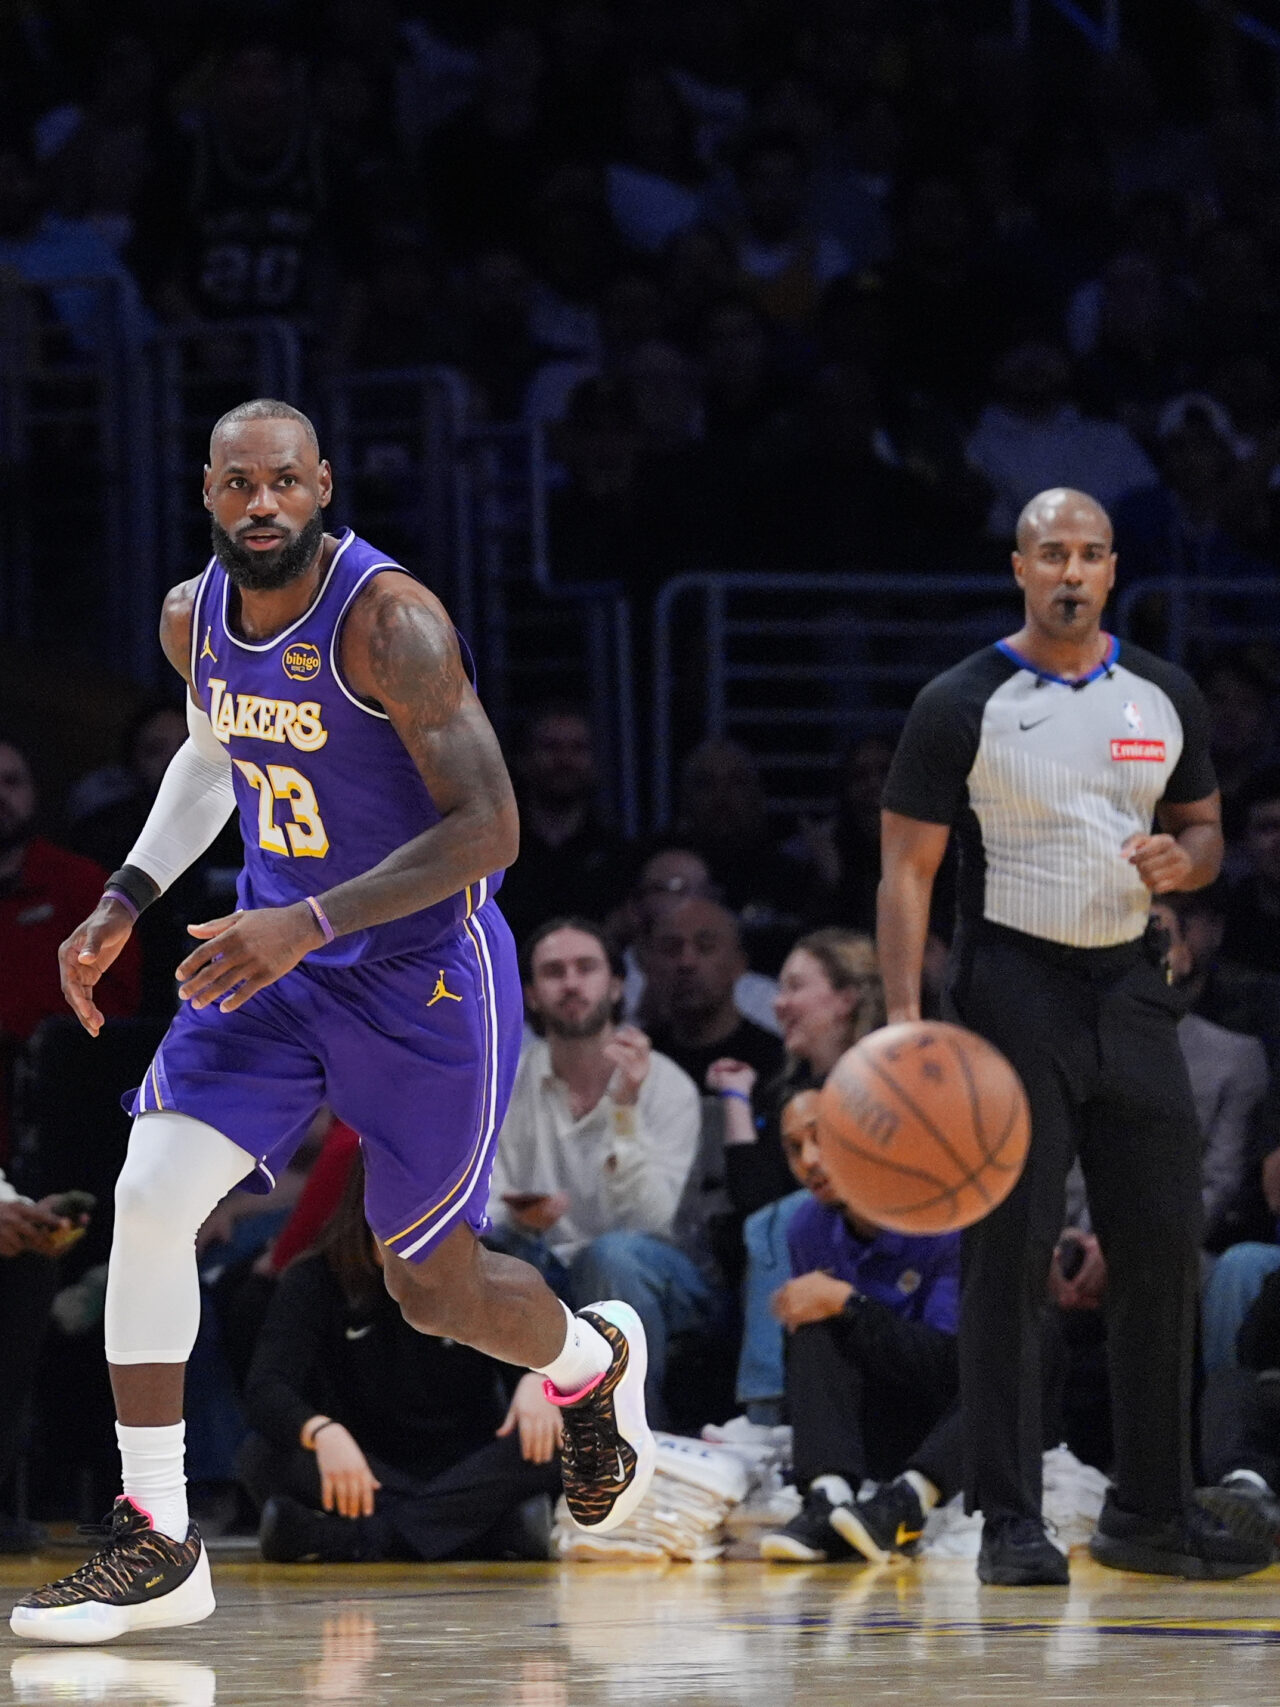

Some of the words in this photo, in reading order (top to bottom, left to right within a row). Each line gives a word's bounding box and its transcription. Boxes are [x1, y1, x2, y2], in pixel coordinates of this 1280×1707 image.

[286, 652, 318, 671] bibigo
[207, 678, 328, 752] LAKERS
[231, 758, 329, 858] 23
